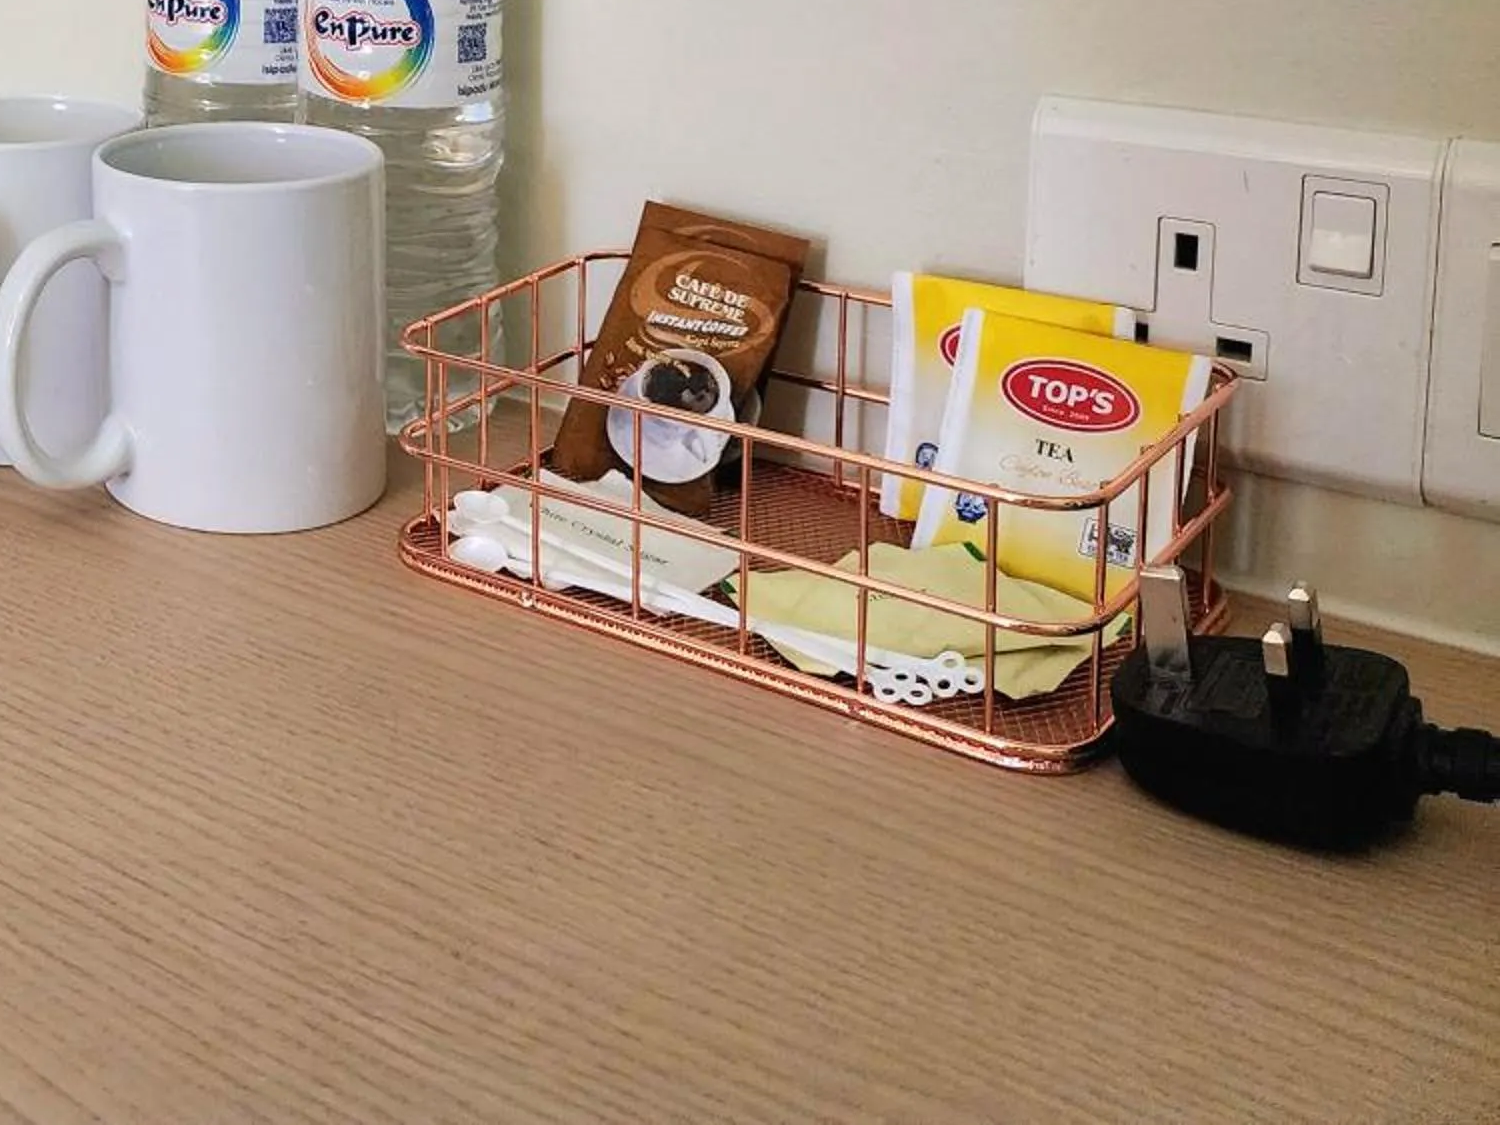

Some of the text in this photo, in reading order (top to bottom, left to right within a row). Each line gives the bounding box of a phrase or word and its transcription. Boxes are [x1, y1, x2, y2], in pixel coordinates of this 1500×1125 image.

[666, 286, 746, 326] SUPREME
[723, 289, 752, 309] DE
[646, 310, 750, 337] INSTANT COFFEE
[1027, 374, 1116, 415] TOP'S
[1035, 438, 1075, 463] TEA
